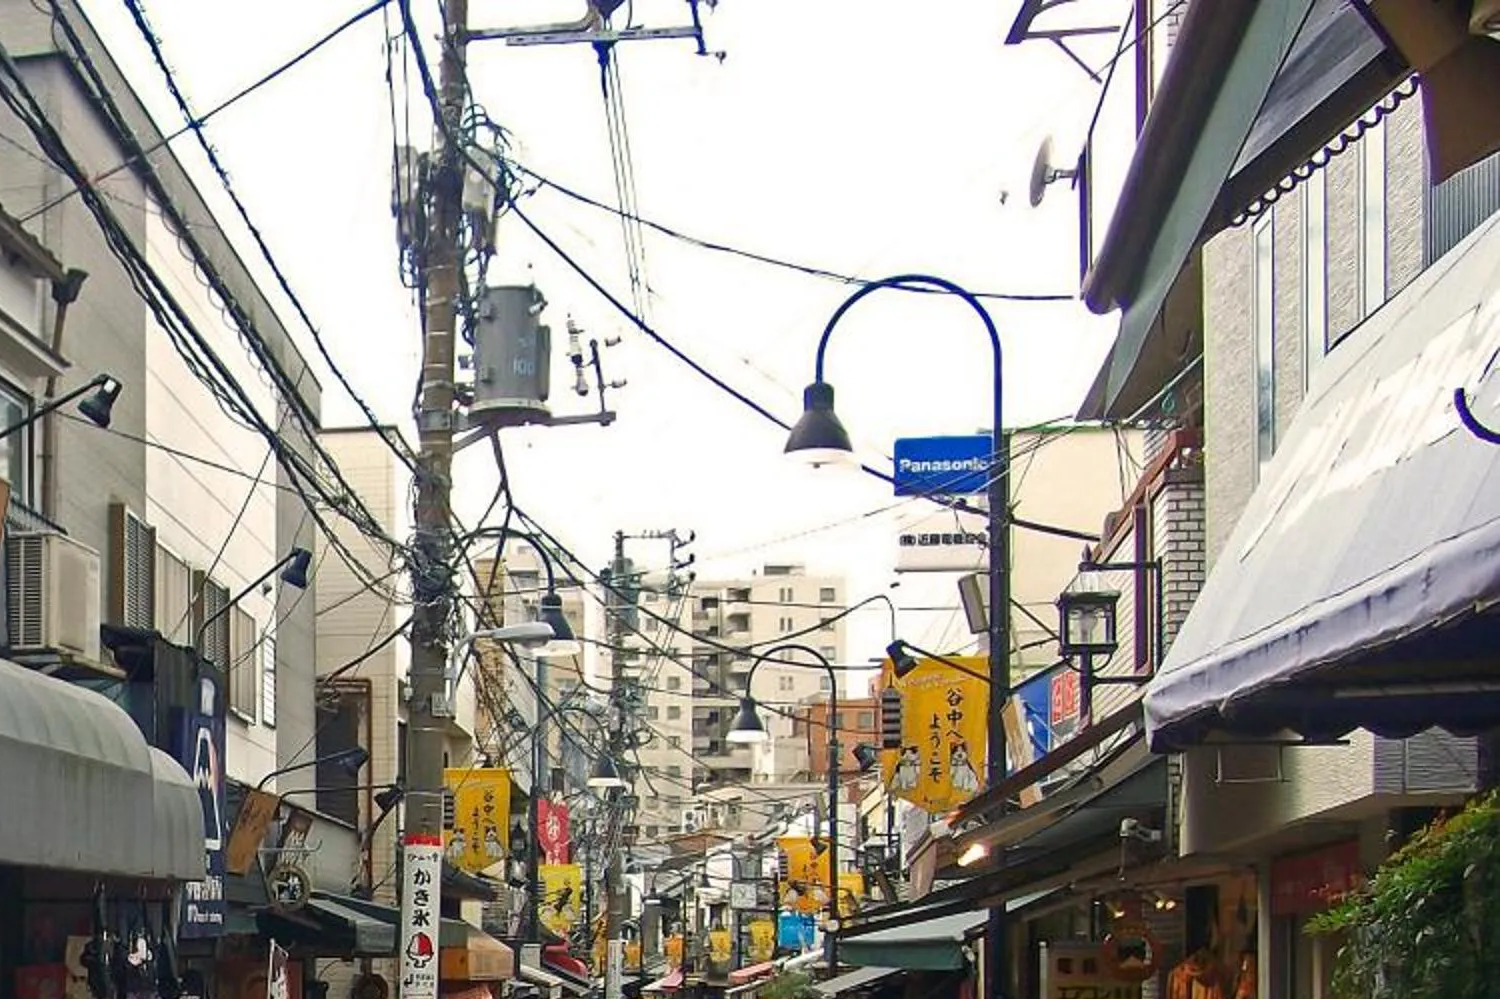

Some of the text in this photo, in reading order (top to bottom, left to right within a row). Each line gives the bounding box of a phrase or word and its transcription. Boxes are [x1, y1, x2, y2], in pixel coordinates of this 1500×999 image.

[899, 457, 988, 474] Panasonic
[946, 687, 964, 741] 谷中へ
[929, 714, 943, 783] ようこそ
[411, 867, 432, 927] かき氷
